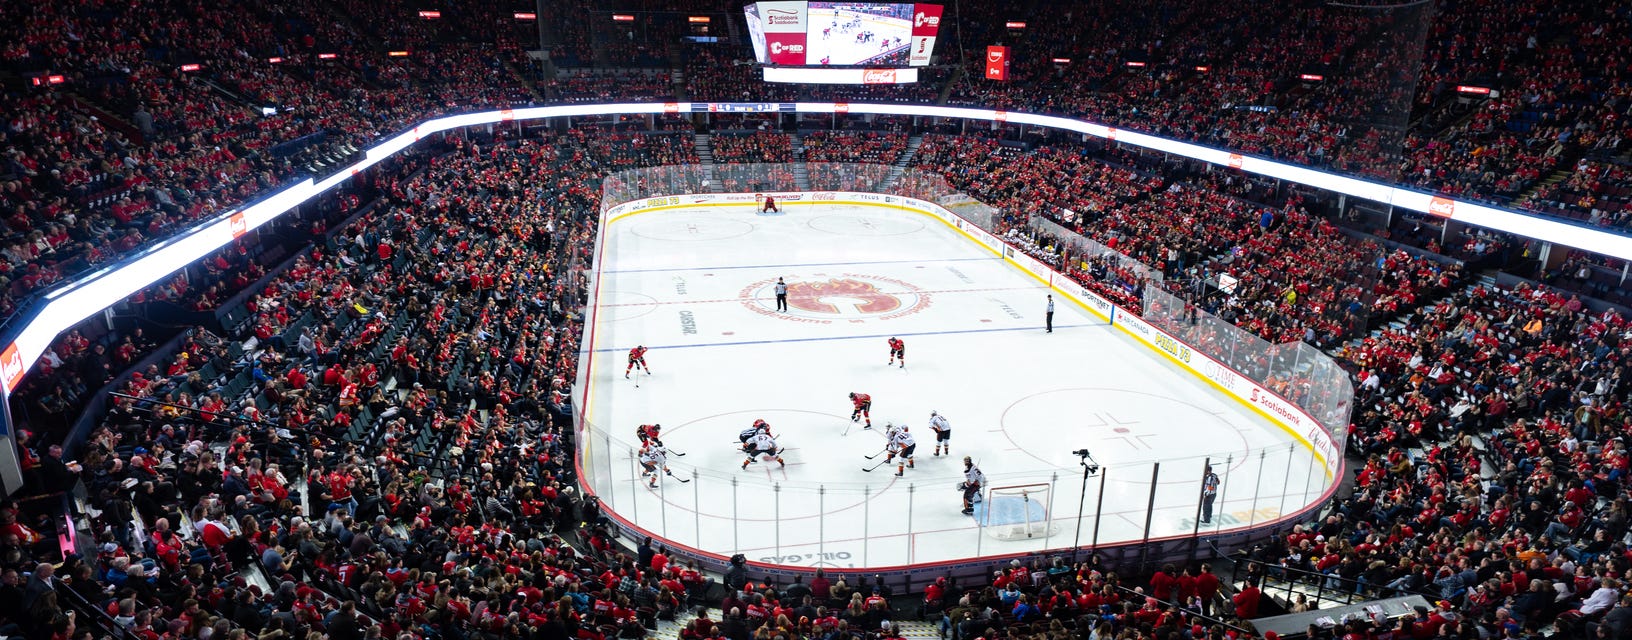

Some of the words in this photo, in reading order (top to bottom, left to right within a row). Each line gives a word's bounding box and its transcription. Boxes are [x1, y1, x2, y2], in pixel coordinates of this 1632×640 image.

[647, 198, 667, 207] PIZZA
[669, 196, 679, 205] 73
[1081, 290, 1110, 310] SPORTSNET
[1131, 320, 1149, 334] CANADA
[1155, 332, 1178, 356] PIZZA
[1179, 345, 1192, 363] 73
[1216, 365, 1236, 385] TIME
[1261, 395, 1301, 426] Scotiabank
[760, 555, 802, 563] GAS
[817, 551, 852, 560] OIL
